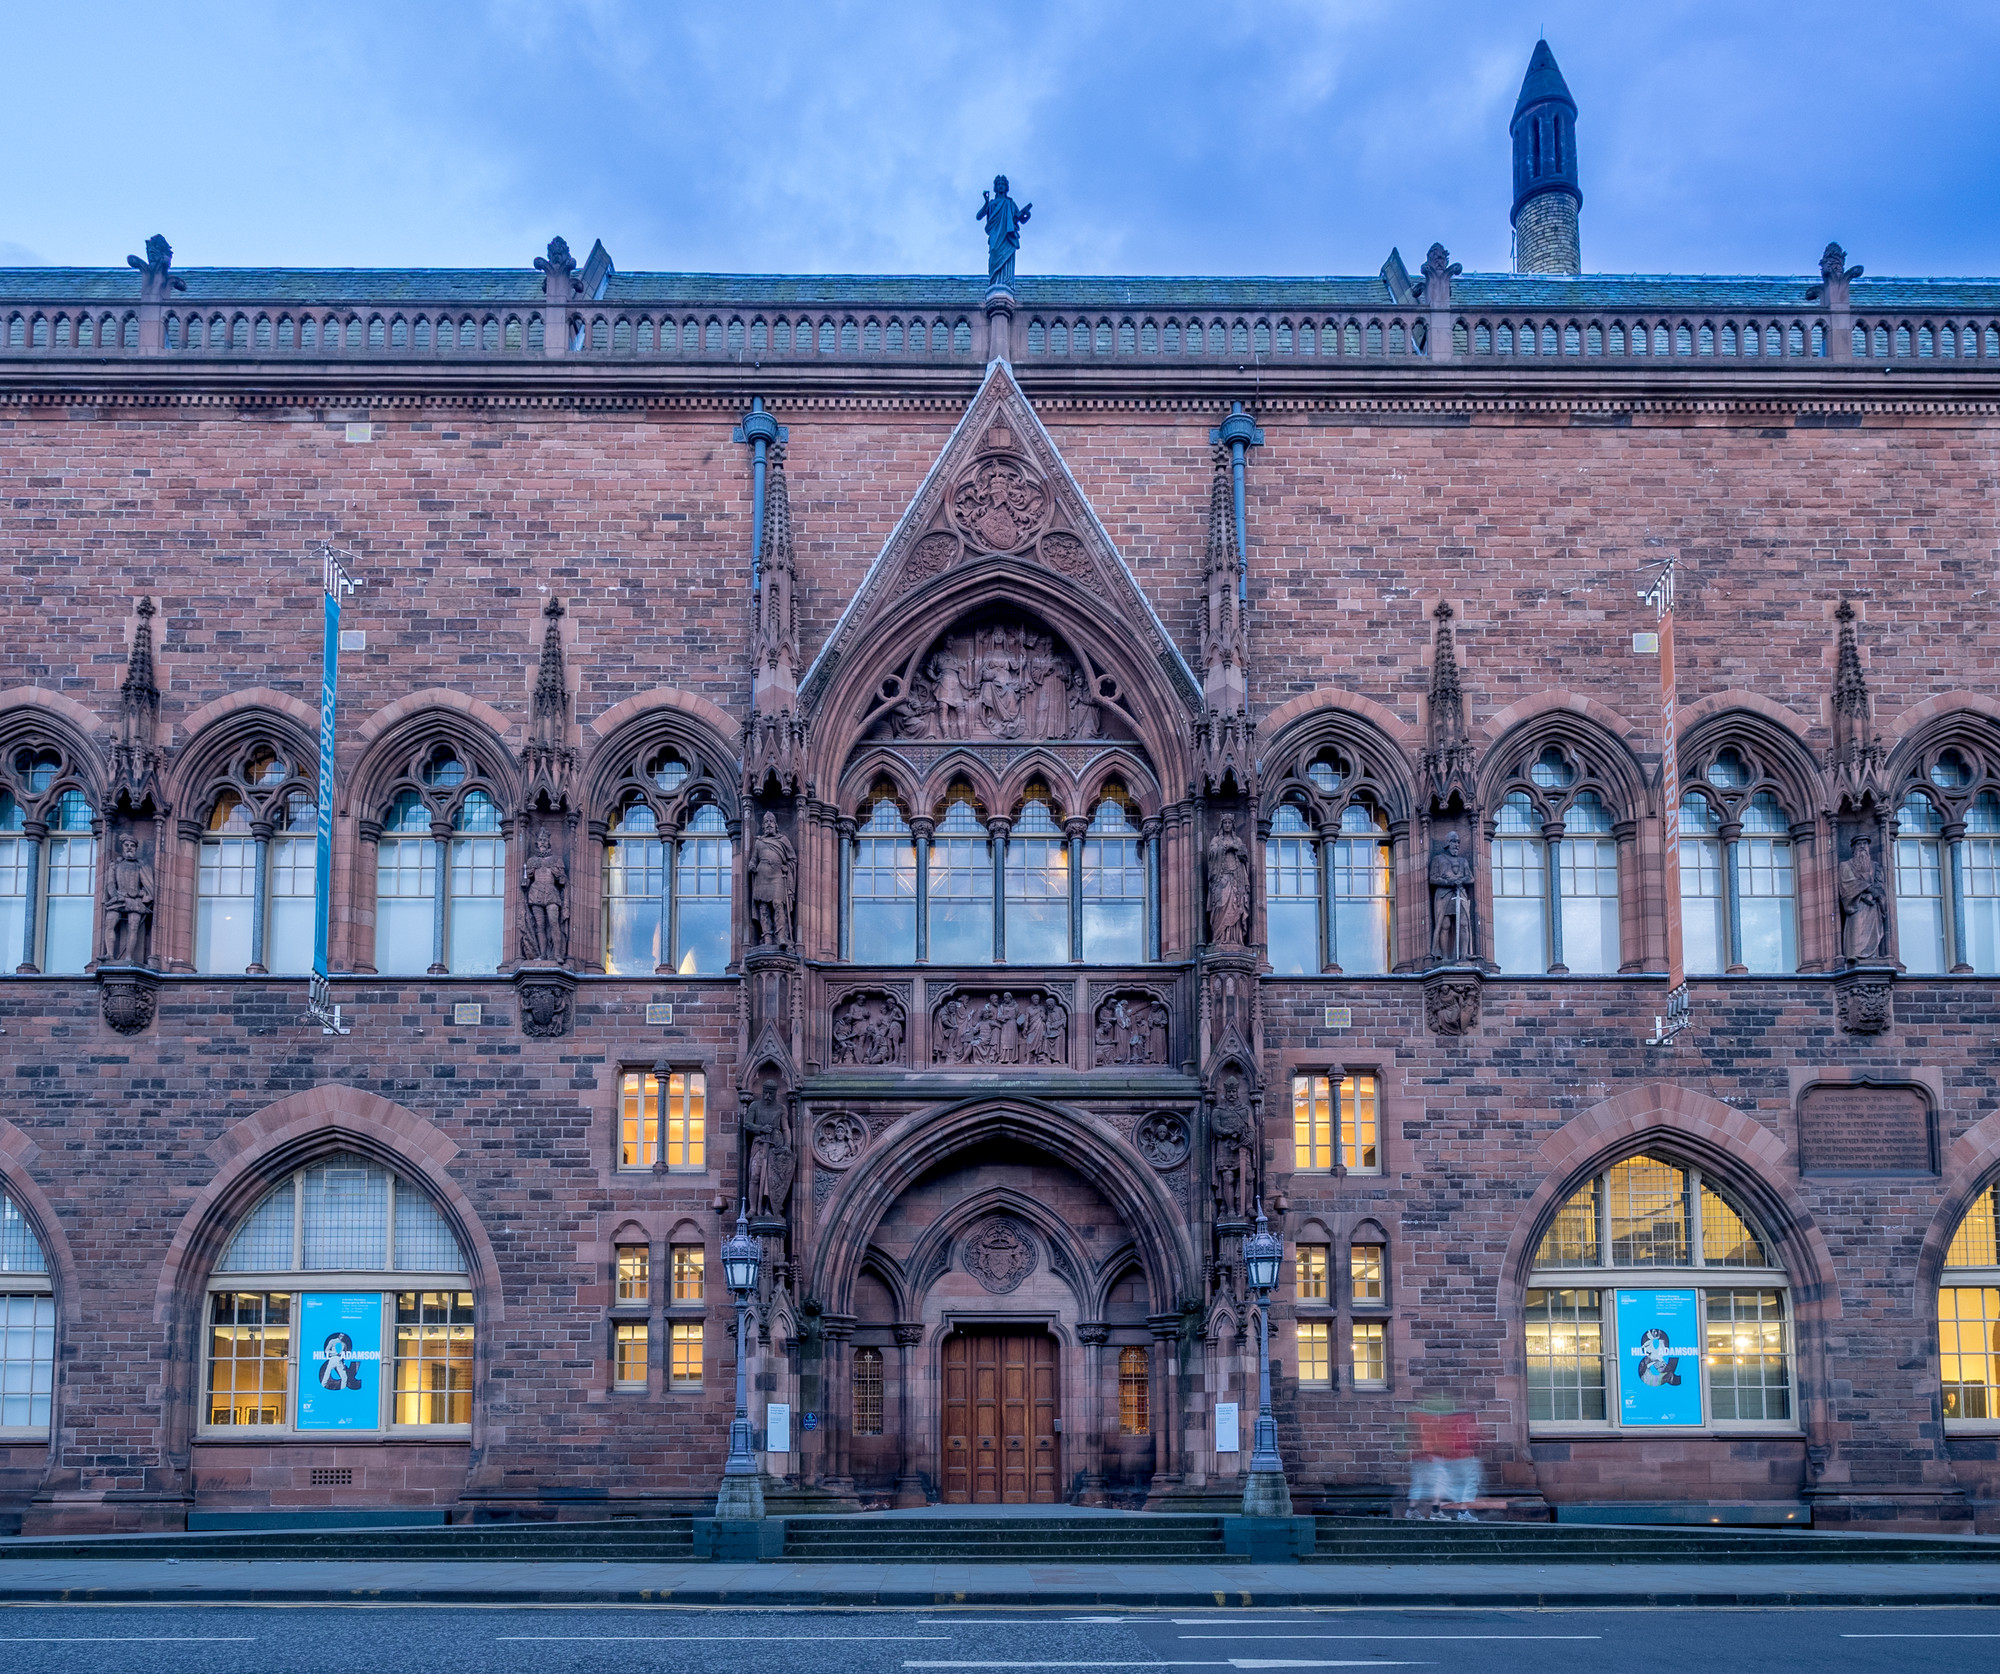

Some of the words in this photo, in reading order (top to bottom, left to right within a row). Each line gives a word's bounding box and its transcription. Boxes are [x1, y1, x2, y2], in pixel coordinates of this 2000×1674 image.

[319, 683, 335, 846] PORTRAIT
[1663, 698, 1679, 855] PORTRAIT
[313, 1350, 331, 1360] HILL
[340, 1350, 381, 1361] ADAMSON
[1631, 1347, 1649, 1357] HILL
[1658, 1347, 1699, 1357] ADAMSON
